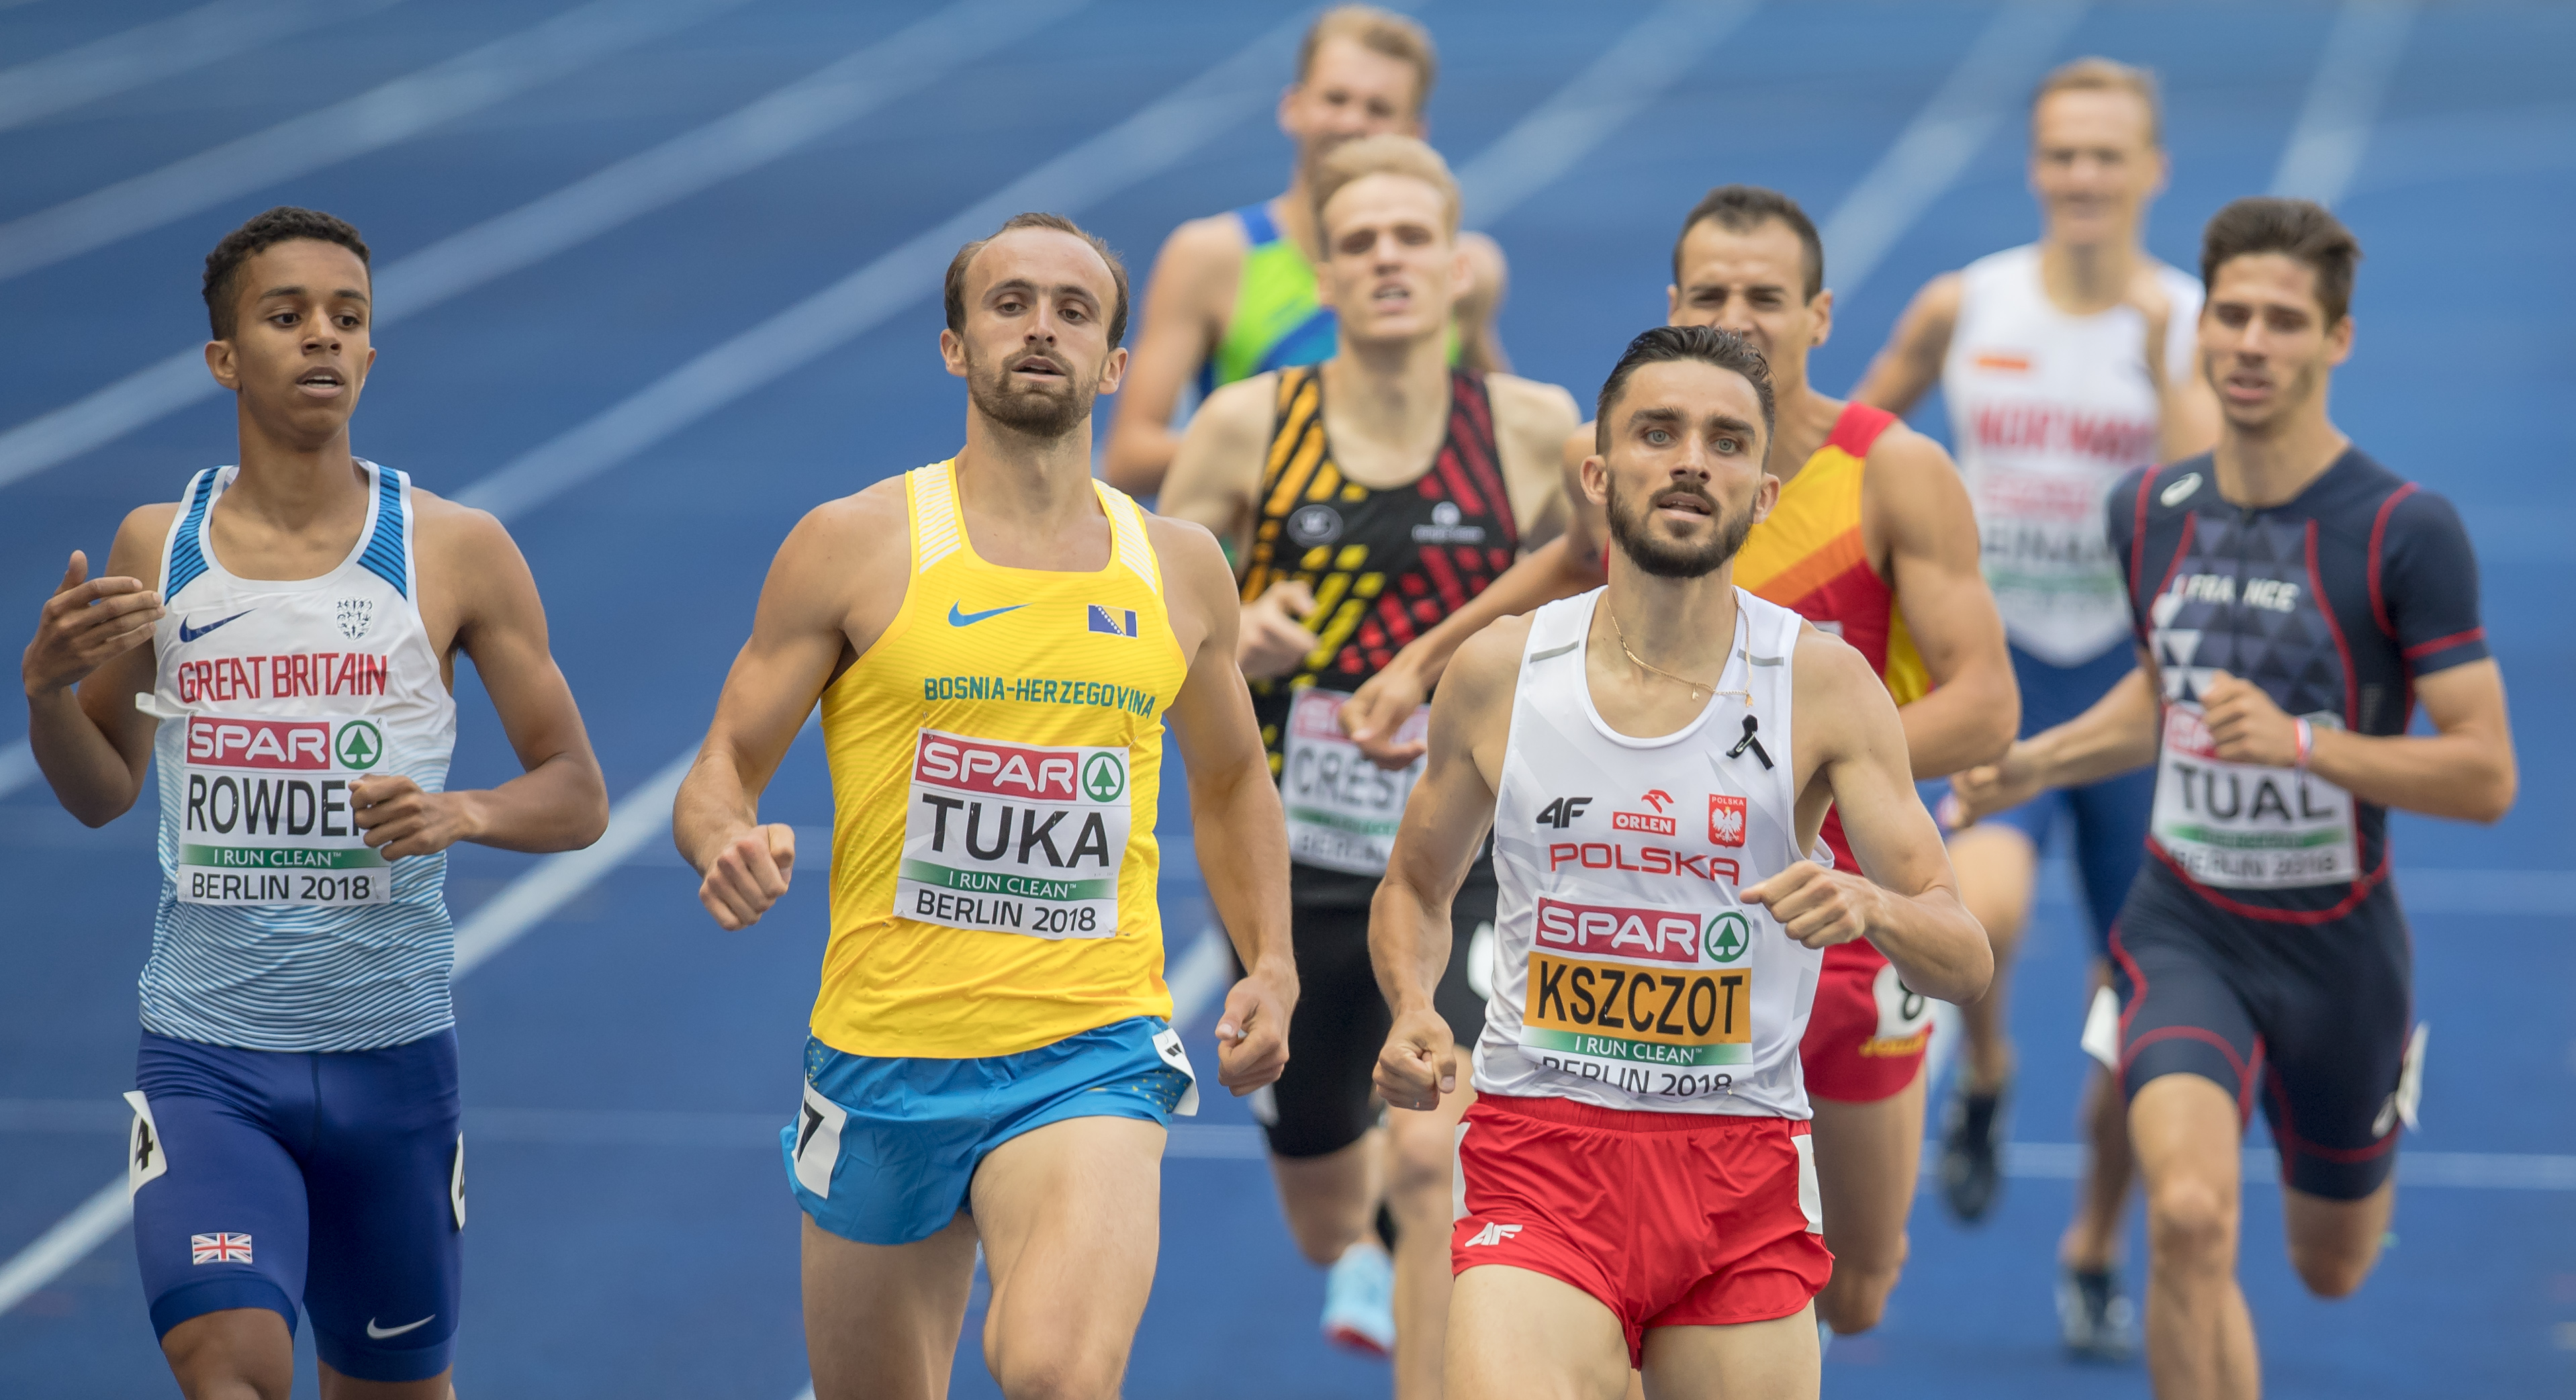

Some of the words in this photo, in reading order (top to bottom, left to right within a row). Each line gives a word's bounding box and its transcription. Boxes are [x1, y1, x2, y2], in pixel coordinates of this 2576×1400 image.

[178, 656, 267, 704] GREAT
[272, 653, 387, 698] BRITAIN
[924, 675, 1156, 719] BOSNIA-HERZEGOVINA
[190, 722, 326, 763] SPAR
[921, 741, 1074, 794] SPAR
[1294, 747, 1418, 810] CRES
[187, 774, 359, 837] ROWDE
[1711, 796, 1745, 806] POLSKA
[2173, 761, 2335, 823] TUAL
[922, 793, 1110, 868] TUKA
[1616, 814, 1672, 833] ORLEN
[214, 849, 218, 864] I
[224, 849, 264, 865] RUN
[1550, 843, 1741, 886] POLSKA
[191, 872, 289, 900] BERLIN
[301, 874, 370, 900] 2018
[948, 871, 954, 885] I
[960, 874, 1001, 891] RUN
[916, 888, 1023, 927] BERLIN
[1031, 906, 1097, 933] 2018
[1540, 905, 1695, 955] SPAR
[1537, 960, 1743, 1035] KSZCZOT
[1586, 1038, 1628, 1058] RUN
[1659, 1072, 1733, 1097] 2018
